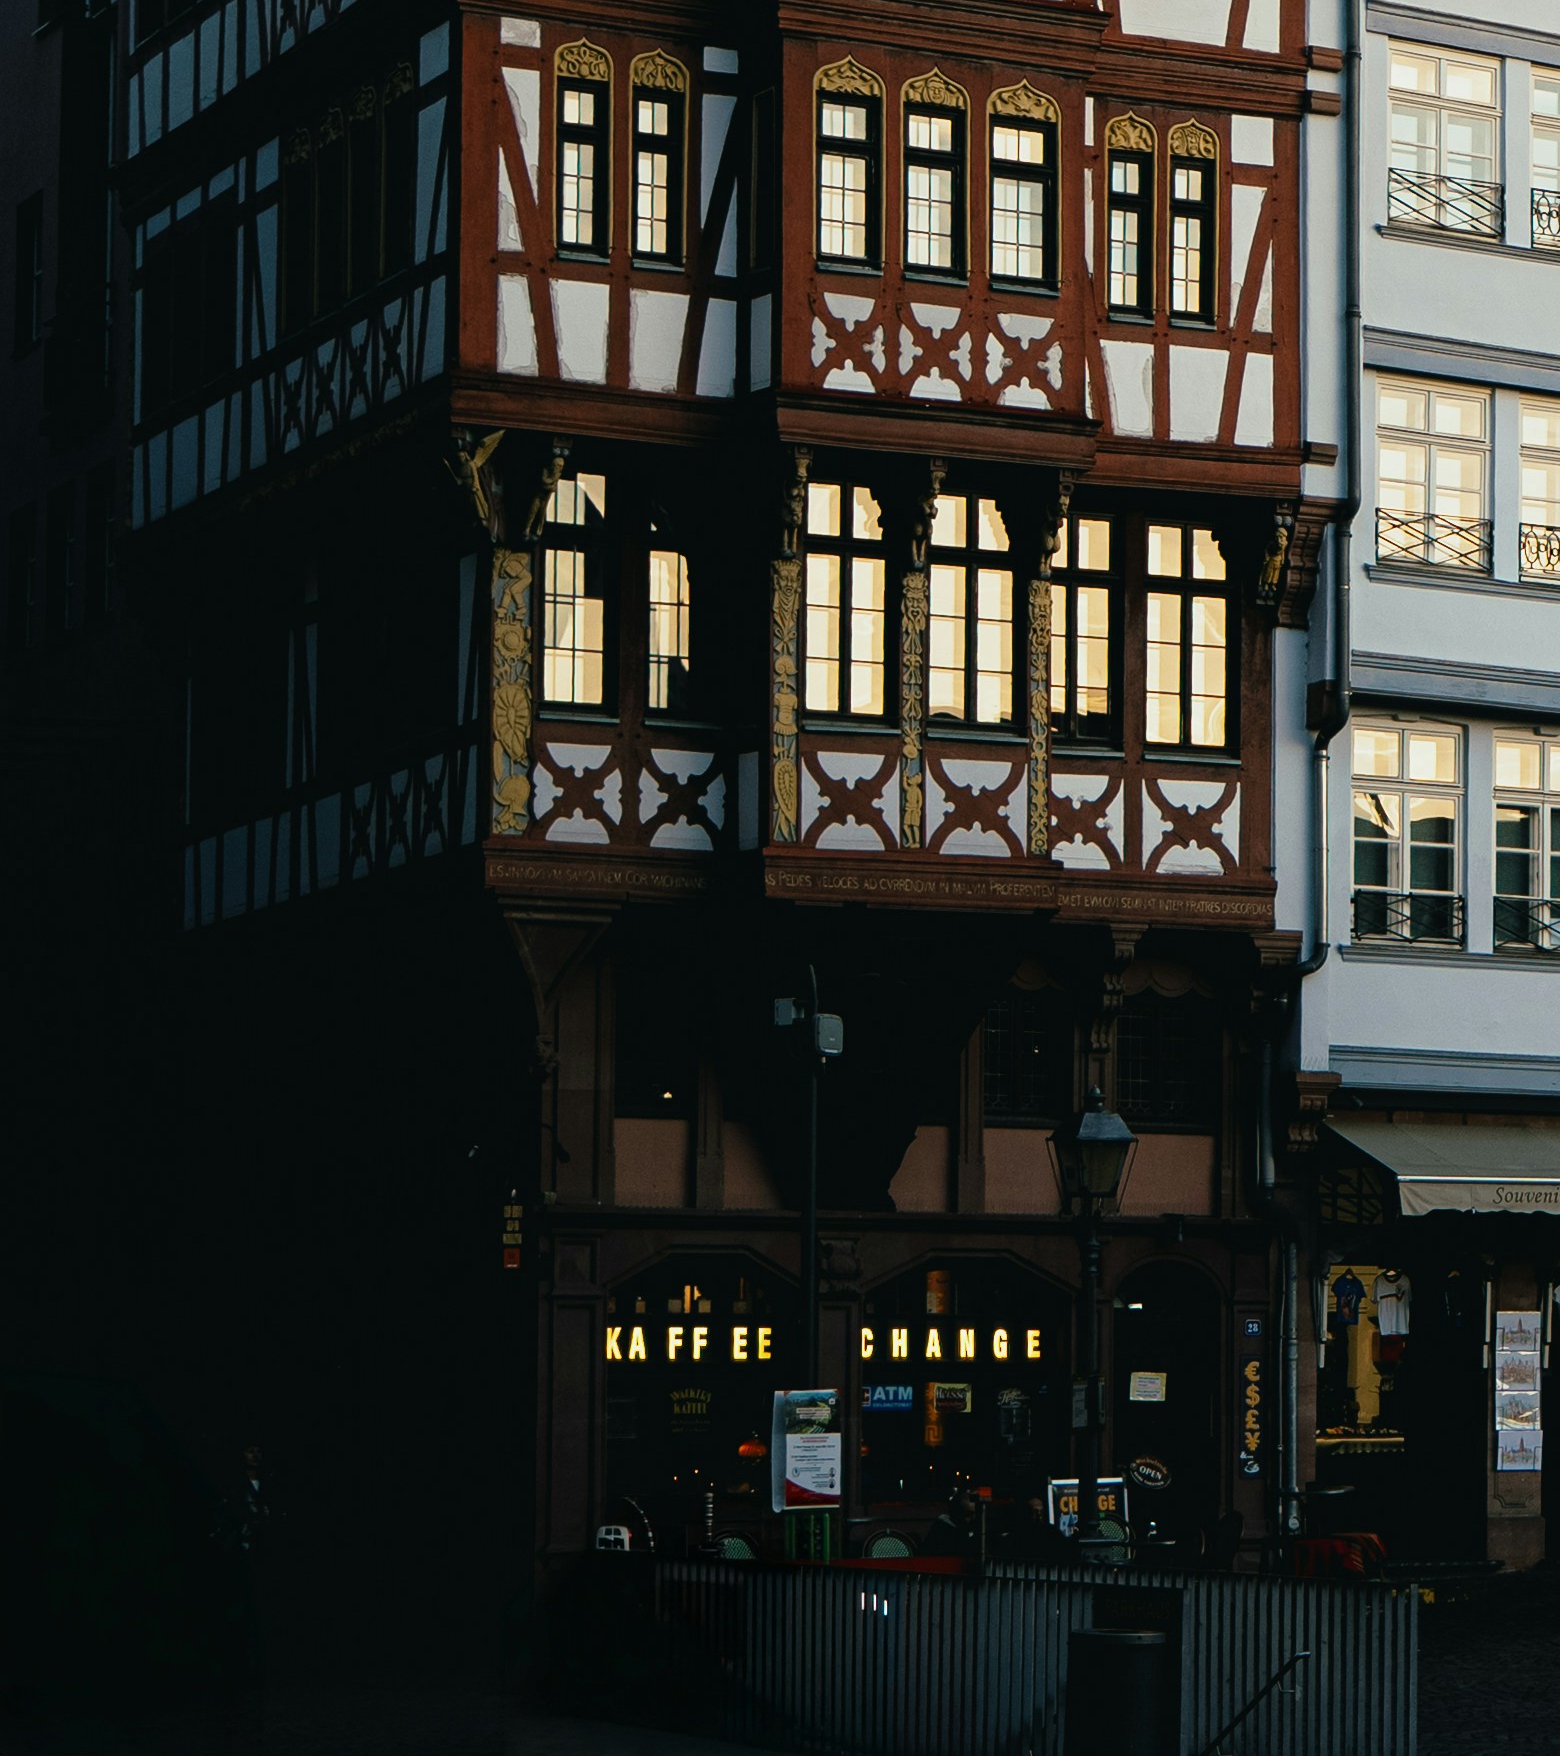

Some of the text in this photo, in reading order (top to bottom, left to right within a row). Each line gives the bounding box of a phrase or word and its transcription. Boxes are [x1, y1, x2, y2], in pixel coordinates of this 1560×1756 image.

[1247, 1323, 1259, 1332] 28
[605, 1326, 772, 1361] KAFFEE
[860, 1327, 1041, 1359] CHANGE
[872, 1385, 914, 1401] ATM
[1138, 1465, 1163, 1480] OPEN
[1060, 1494, 1116, 1513] CHGE
